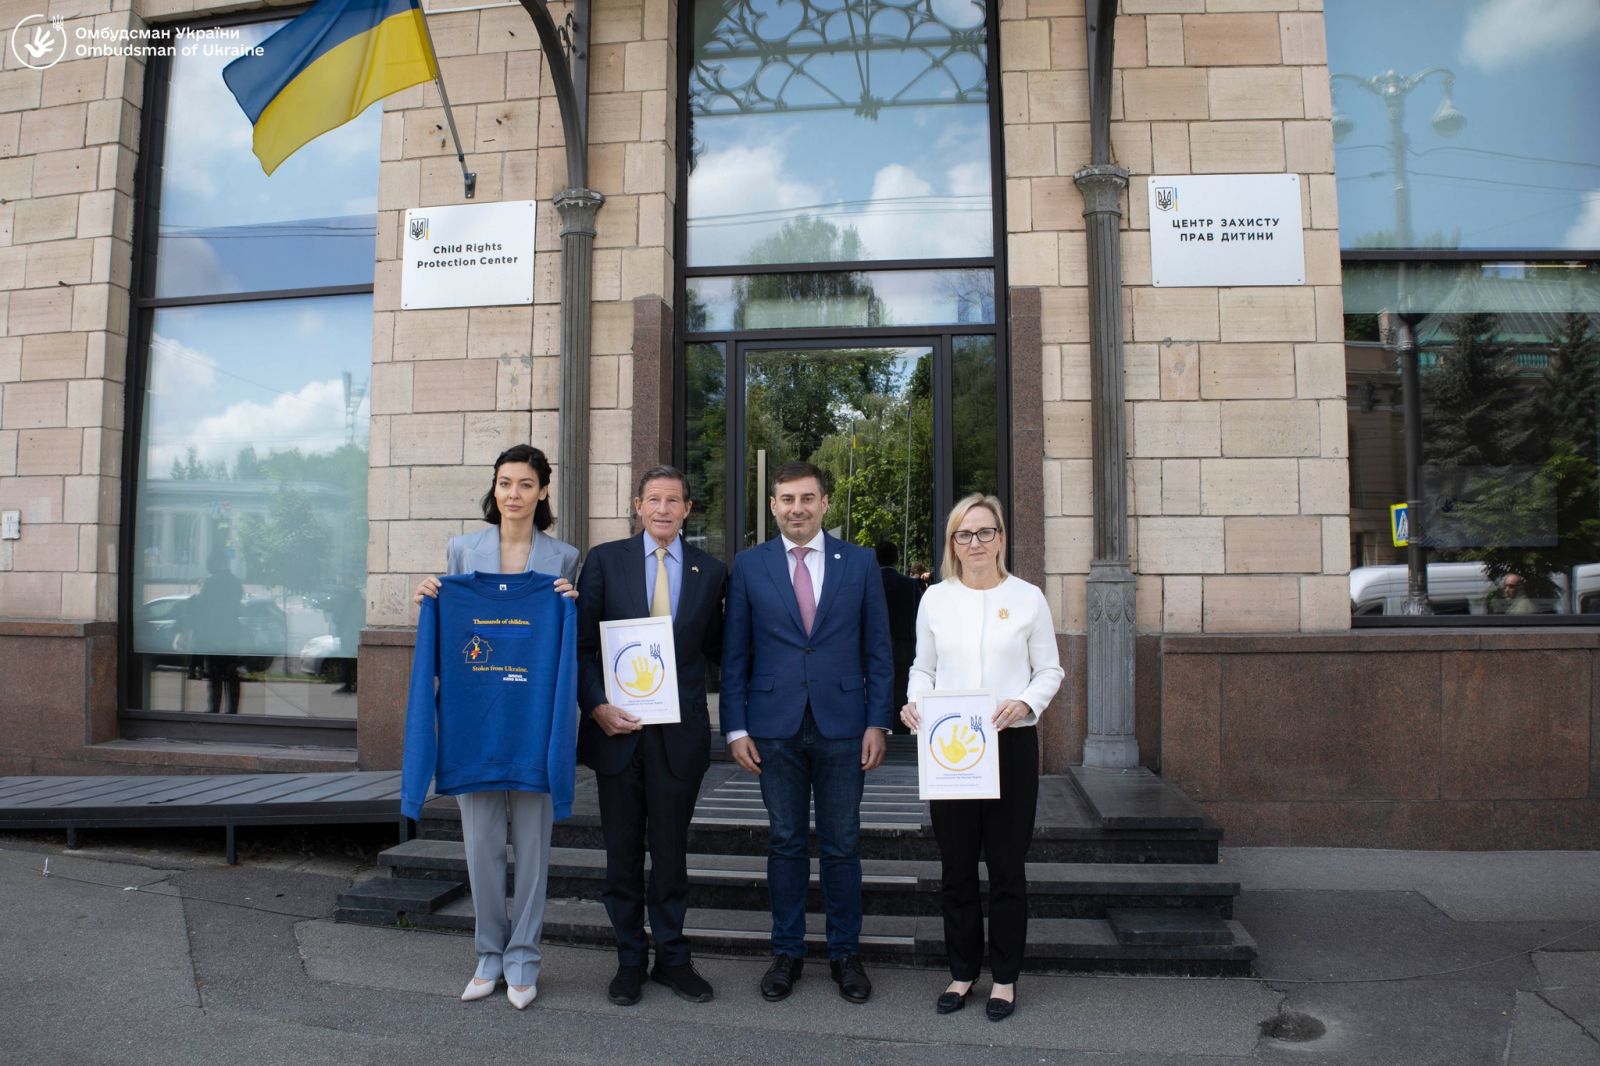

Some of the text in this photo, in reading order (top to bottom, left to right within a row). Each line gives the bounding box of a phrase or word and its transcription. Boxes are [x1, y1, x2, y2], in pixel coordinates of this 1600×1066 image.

[1172, 218, 1280, 229] ЦЕНТР ЗАХИСТУ
[1180, 232, 1274, 242] ПРАВ ДИТИНИ
[433, 243, 502, 254] Child Rights
[417, 256, 518, 269] Protection Center
